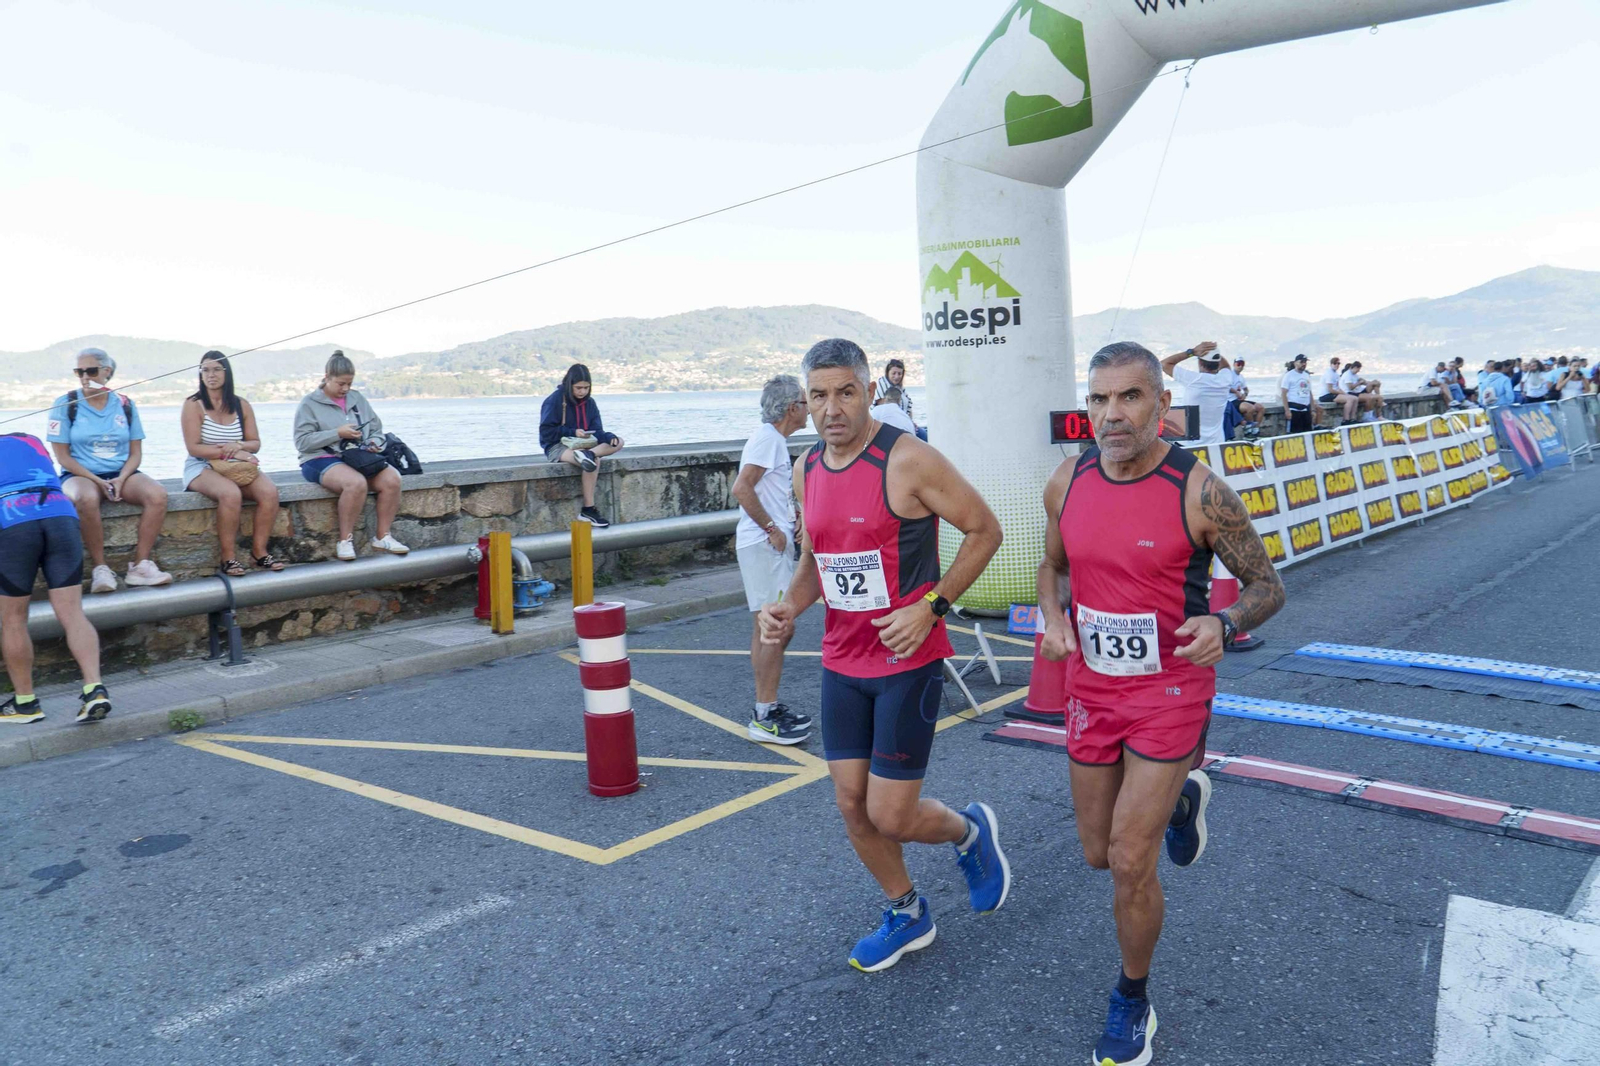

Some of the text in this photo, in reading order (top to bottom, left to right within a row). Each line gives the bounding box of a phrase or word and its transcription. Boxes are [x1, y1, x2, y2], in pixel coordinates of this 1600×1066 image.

[1287, 477, 1318, 504] GADIS
[1291, 521, 1321, 550] GADIS
[833, 556, 858, 566] ALFONSO
[859, 553, 879, 564] MORO
[835, 573, 869, 596] 92
[1096, 615, 1129, 628] ALFONSO
[1130, 618, 1154, 628] MORO
[1090, 632, 1148, 660] 139
